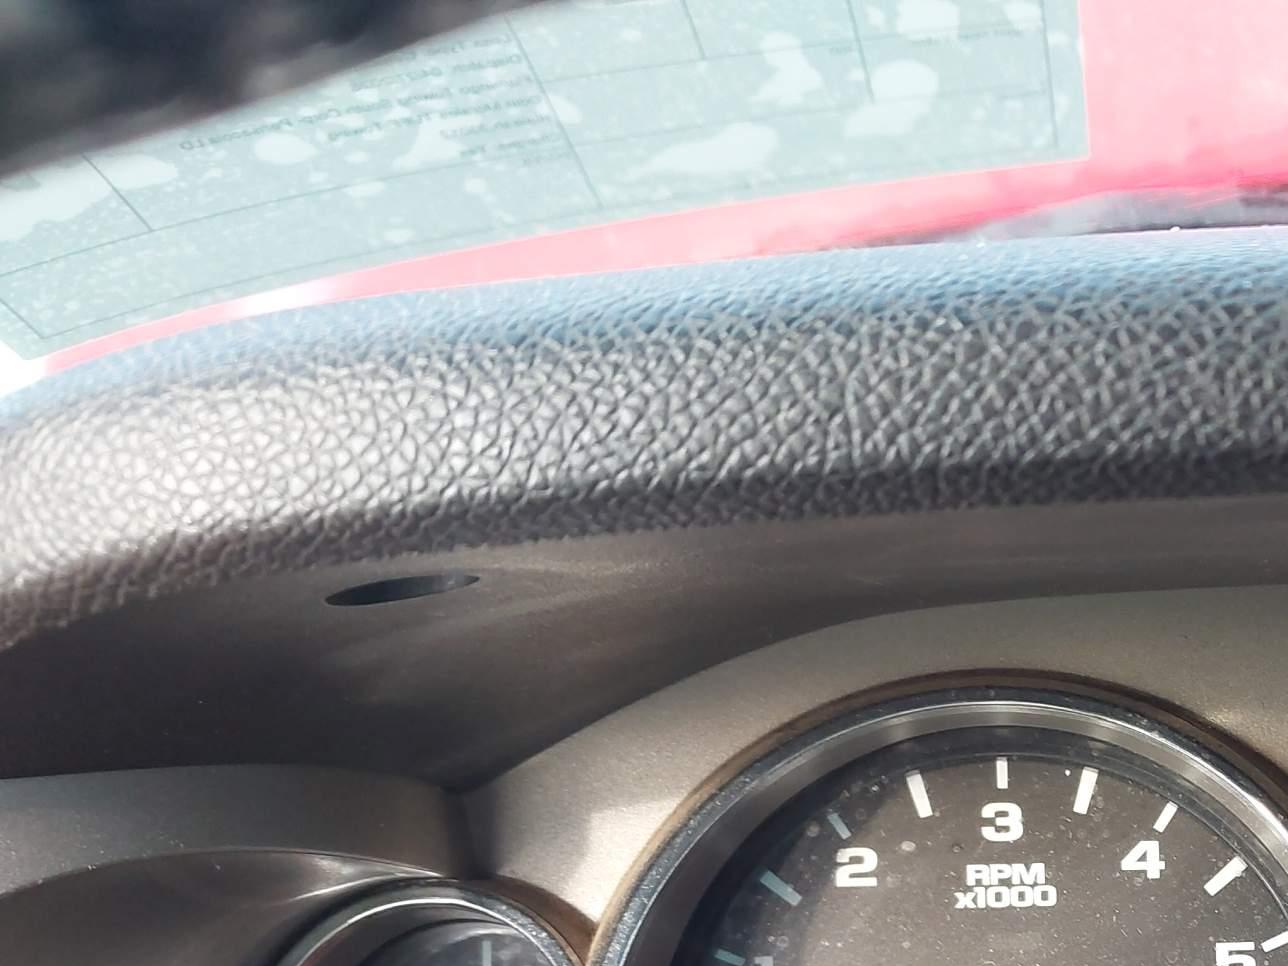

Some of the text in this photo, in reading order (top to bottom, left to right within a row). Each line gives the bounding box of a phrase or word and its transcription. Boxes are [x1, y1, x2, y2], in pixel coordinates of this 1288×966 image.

[981, 803, 1023, 843] 3
[836, 848, 877, 887] 2
[966, 863, 1045, 886] RPM
[1121, 841, 1165, 879] 4
[954, 885, 1057, 908] x1000
